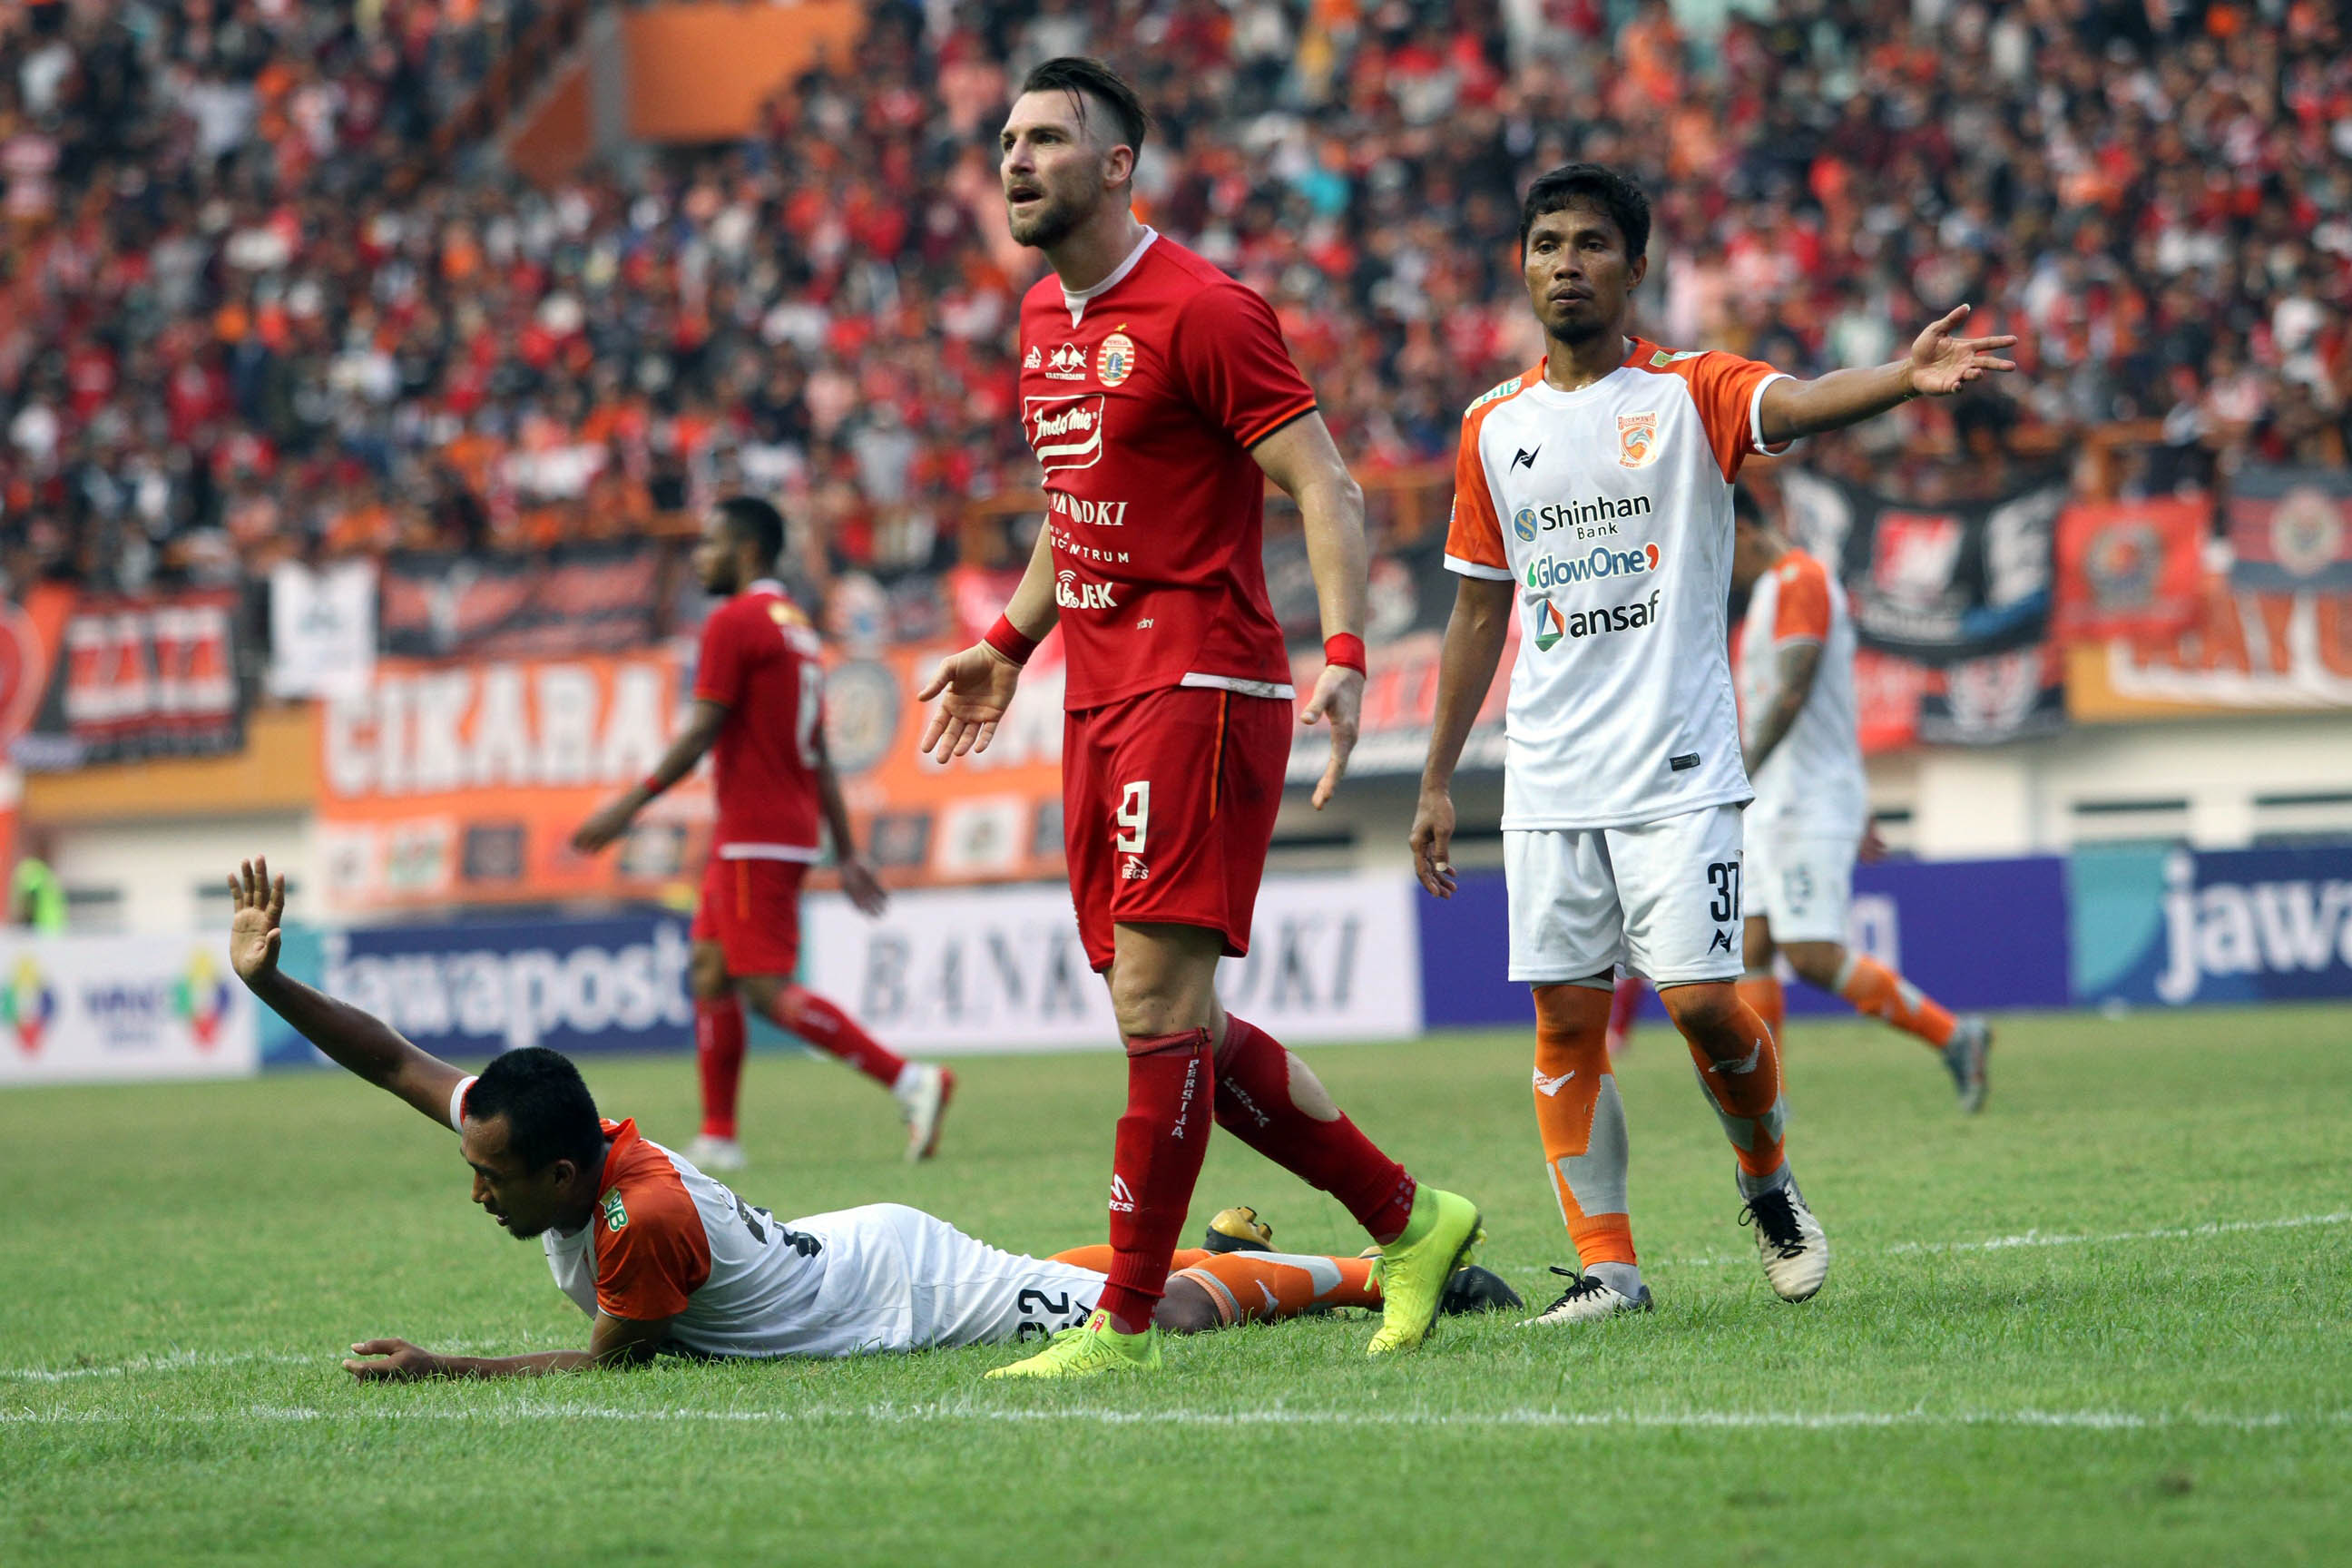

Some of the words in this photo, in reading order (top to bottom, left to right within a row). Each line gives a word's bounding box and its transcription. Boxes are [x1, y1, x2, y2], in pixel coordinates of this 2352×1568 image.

[1080, 500, 1129, 525] DKI
[1540, 495, 1651, 531] Shinhan
[1576, 522, 1619, 540] Bank
[1537, 546, 1646, 589] GlowOne
[1570, 589, 1660, 638] ansaf
[1117, 780, 1150, 853] 9
[1707, 861, 1739, 922] 37
